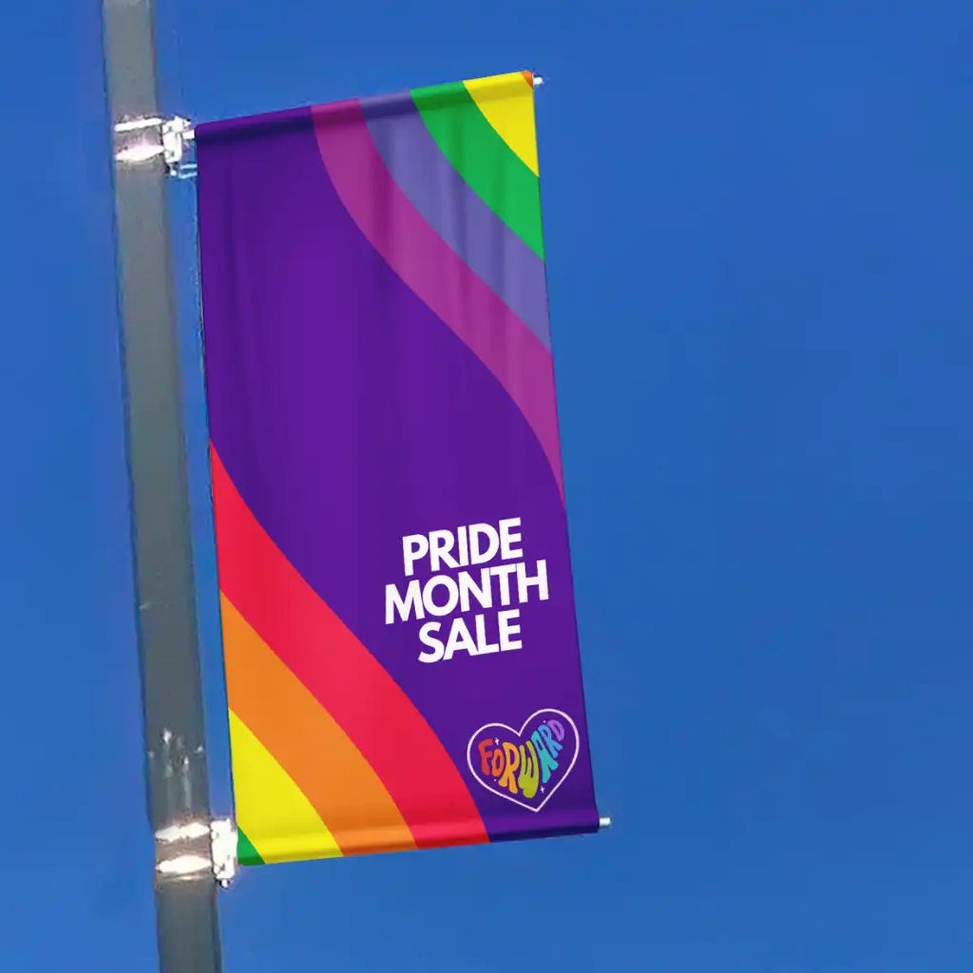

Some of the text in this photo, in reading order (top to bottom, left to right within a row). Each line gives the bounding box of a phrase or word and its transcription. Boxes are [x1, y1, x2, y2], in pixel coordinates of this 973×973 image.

[402, 517, 523, 577] PRIDE
[384, 559, 549, 625] MONTH
[418, 608, 523, 664] SALE
[478, 719, 566, 798] FORWARD
